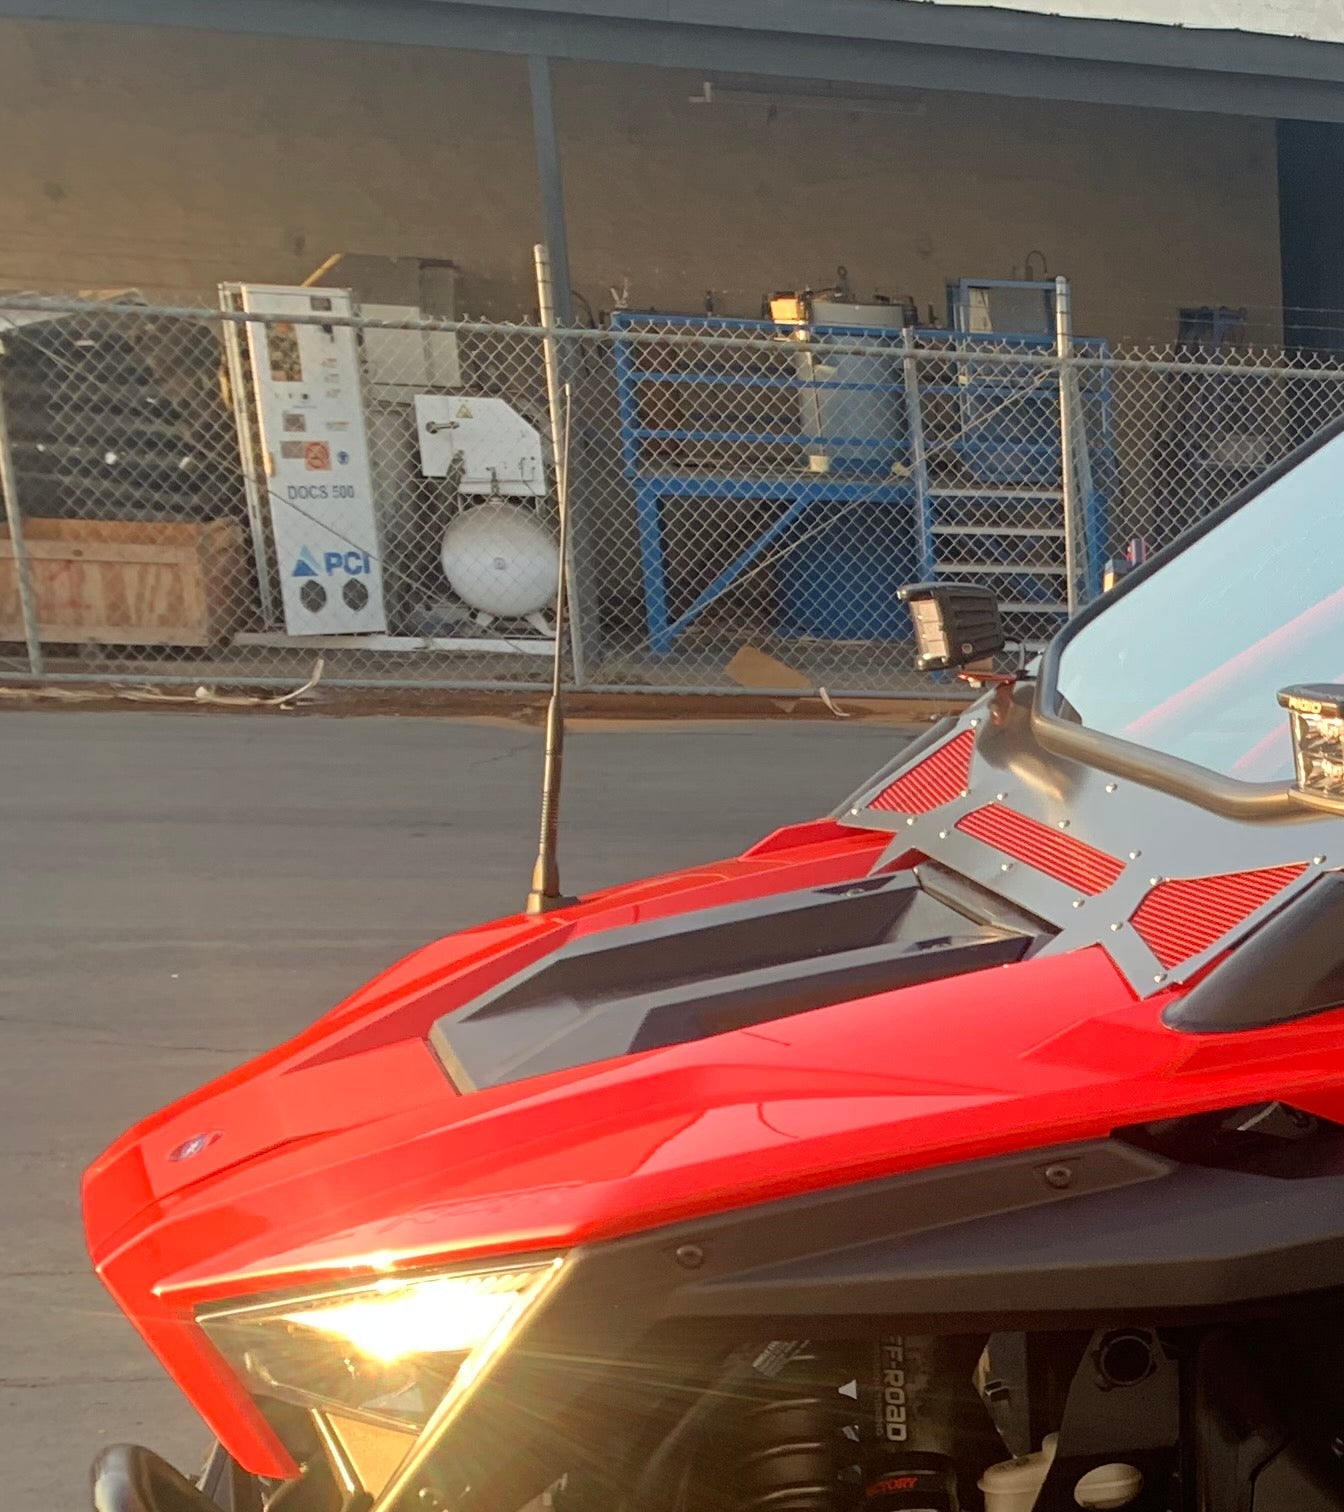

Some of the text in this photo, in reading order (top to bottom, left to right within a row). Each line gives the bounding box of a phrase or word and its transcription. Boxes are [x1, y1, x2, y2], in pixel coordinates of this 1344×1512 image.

[287, 485, 355, 499] DOCS 500
[324, 551, 371, 576] PCI
